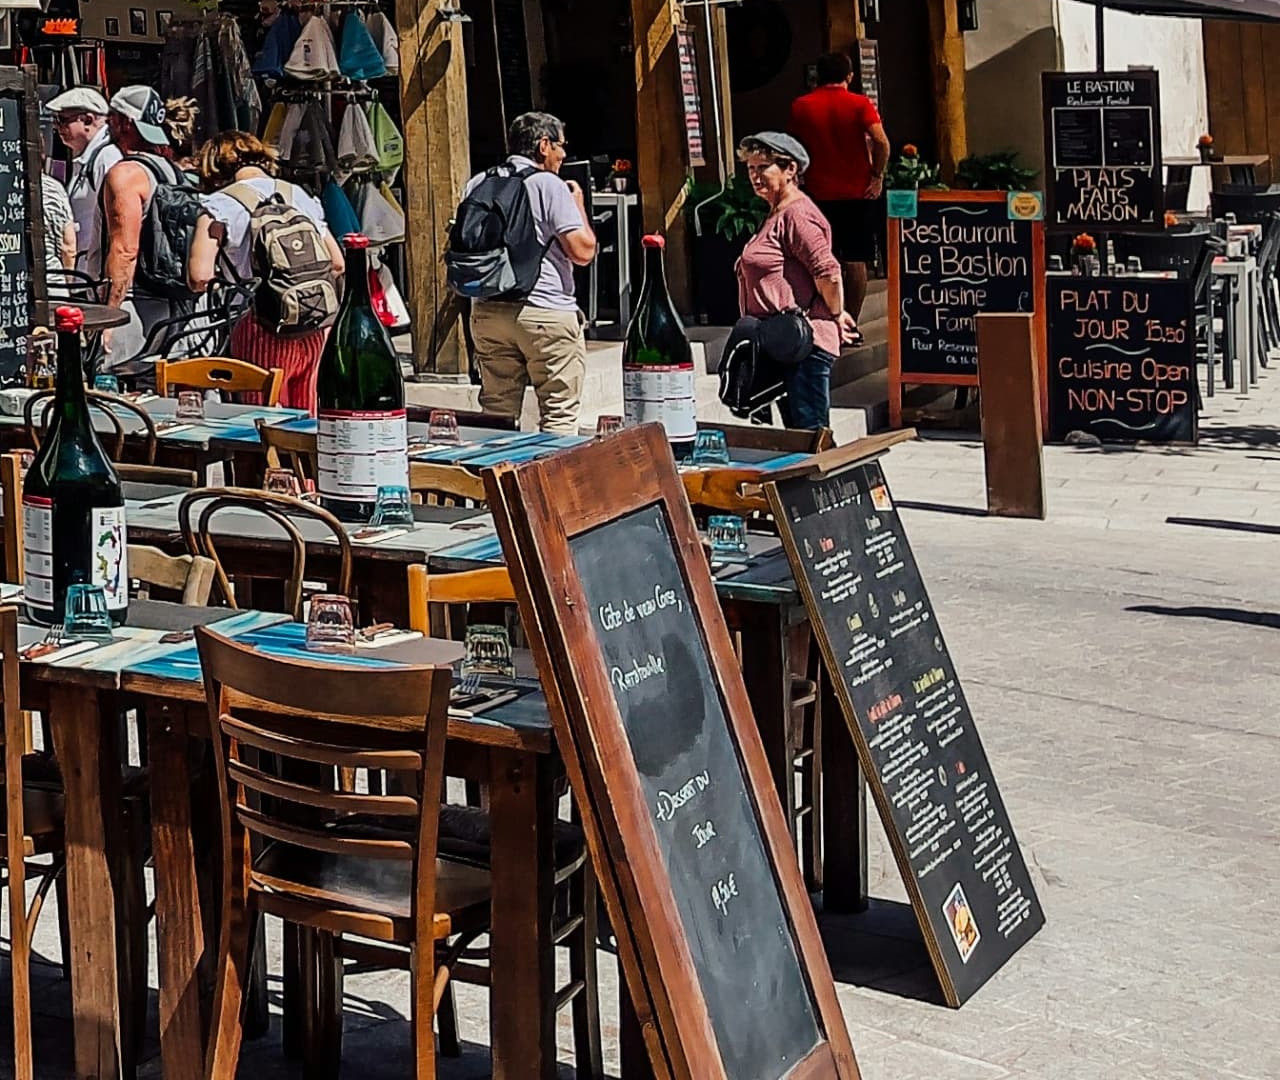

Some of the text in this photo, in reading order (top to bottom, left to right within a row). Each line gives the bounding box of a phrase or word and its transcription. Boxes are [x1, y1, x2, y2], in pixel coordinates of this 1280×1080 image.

[1067, 80, 1135, 94] LE BASTION
[1073, 167, 1136, 189] PLATS
[1080, 185, 1129, 204] FAITS
[1067, 202, 1138, 221] MAISON
[901, 216, 1018, 244] Restaurant
[904, 246, 1027, 277] Le Bastion
[918, 283, 987, 306] Cuisine
[1061, 290, 1150, 313] PLAT DU
[1073, 319, 1130, 340] JOUR
[1059, 357, 1189, 388] Cuisine Open
[1068, 388, 1188, 414] NON-STOP
[623, 600, 636, 622] de
